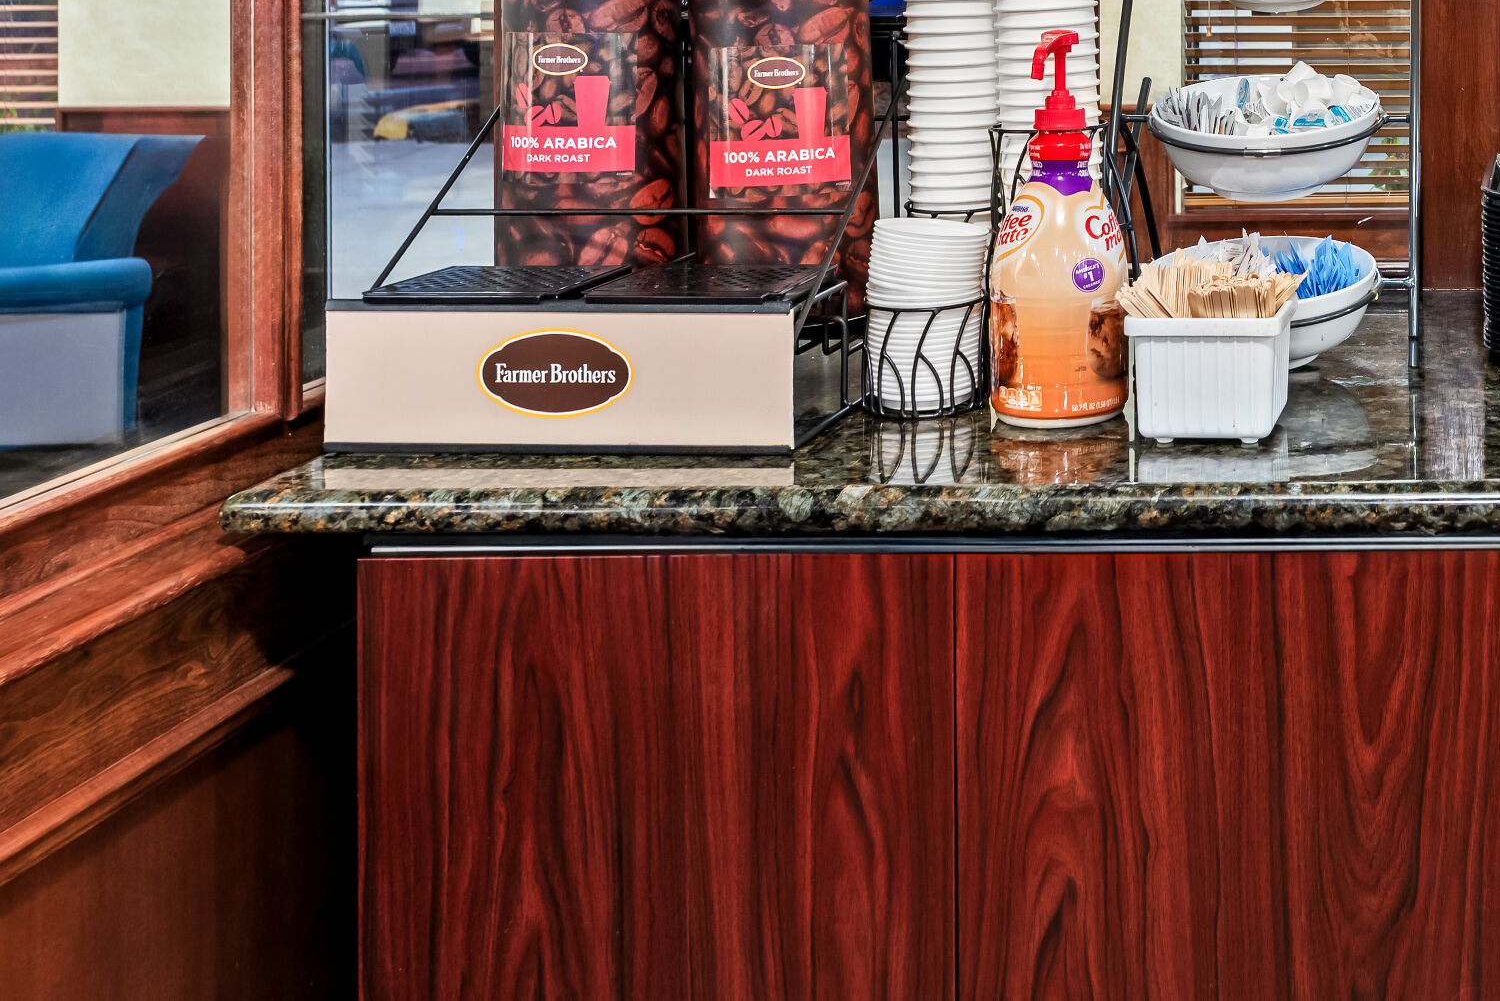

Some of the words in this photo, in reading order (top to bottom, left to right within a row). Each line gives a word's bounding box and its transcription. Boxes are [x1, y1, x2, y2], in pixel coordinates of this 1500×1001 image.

[538, 55, 556, 64] Farmer
[556, 55, 581, 64] Brothers
[754, 70, 774, 78] Farmer
[774, 69, 799, 77] Brothers
[510, 136, 540, 148] 100%
[543, 137, 617, 149] ARABICA
[526, 153, 552, 163] DARK
[554, 154, 591, 163] ROAST
[724, 151, 760, 164] 100%
[764, 147, 836, 163] ARABICA
[745, 167, 774, 177] DARK
[776, 165, 813, 176] ROAST
[998, 228, 1029, 246] ate
[495, 362, 548, 384] Farmer
[550, 363, 617, 384] Brothers
